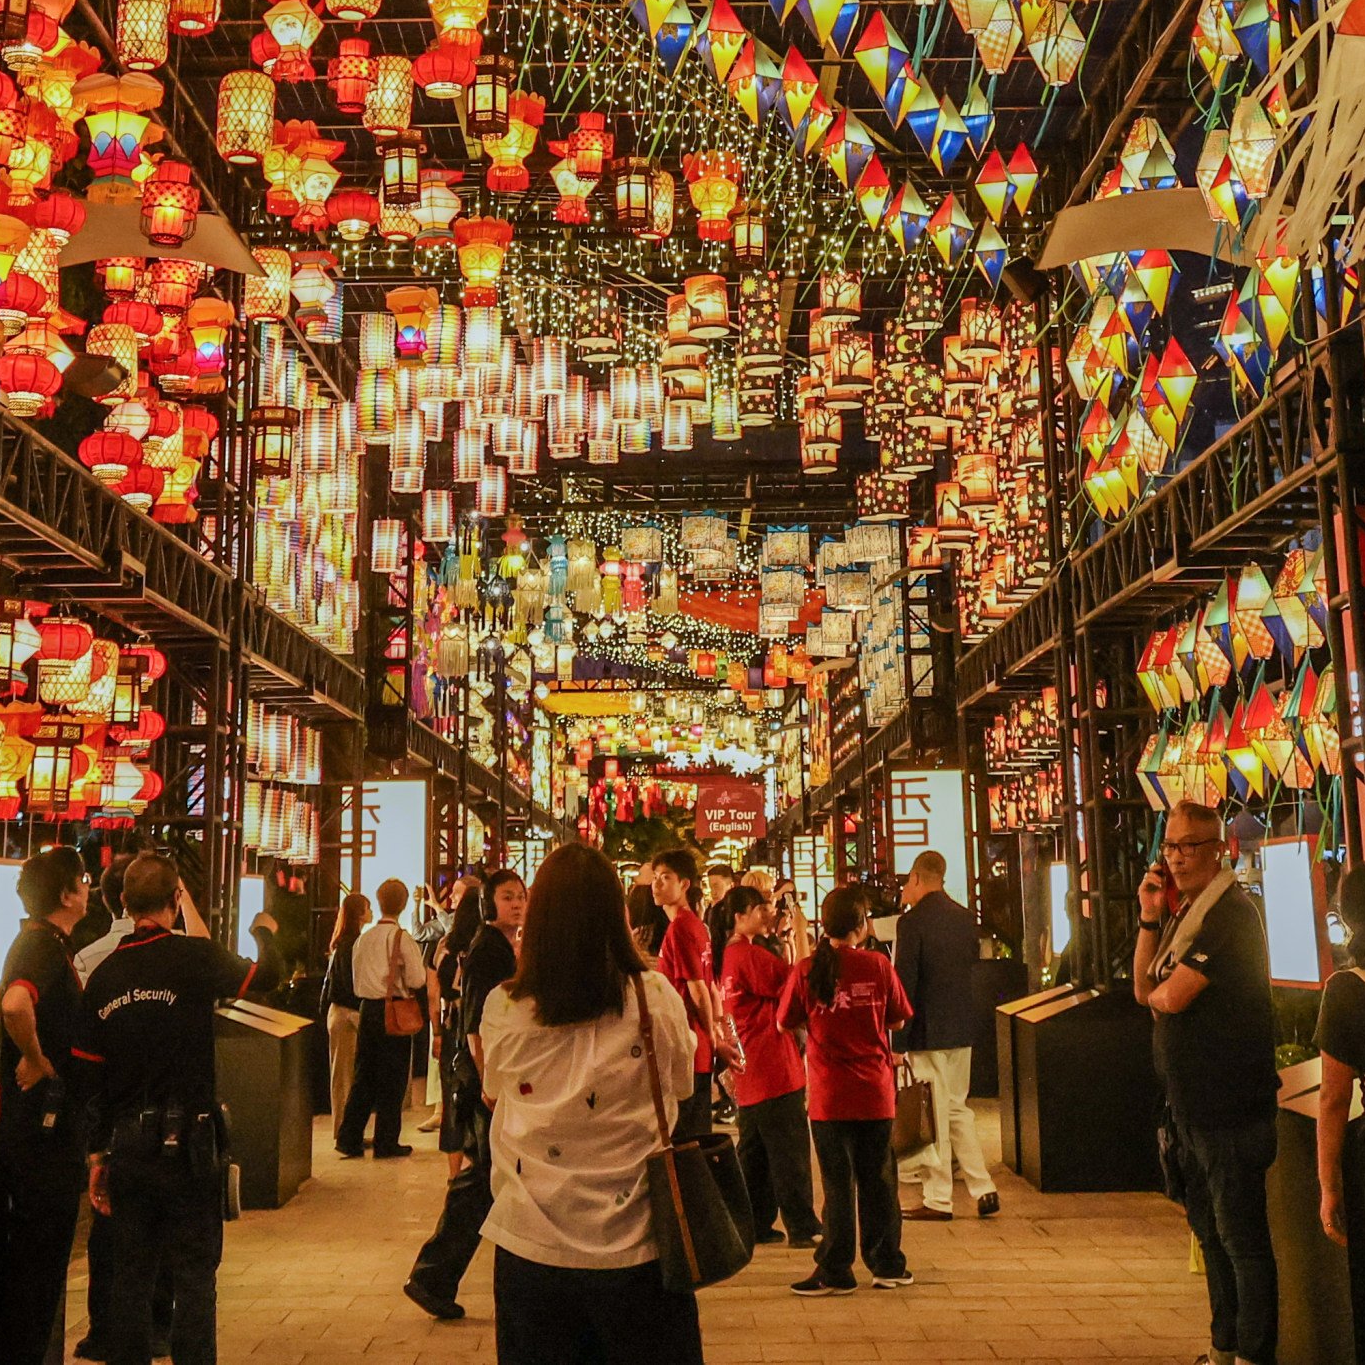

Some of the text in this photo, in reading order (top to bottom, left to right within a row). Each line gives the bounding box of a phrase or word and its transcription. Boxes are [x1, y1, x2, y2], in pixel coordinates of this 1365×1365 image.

[705, 809, 757, 821] VIP Tour
[709, 822, 752, 833] (English)
[98, 988, 177, 1020] General Security
